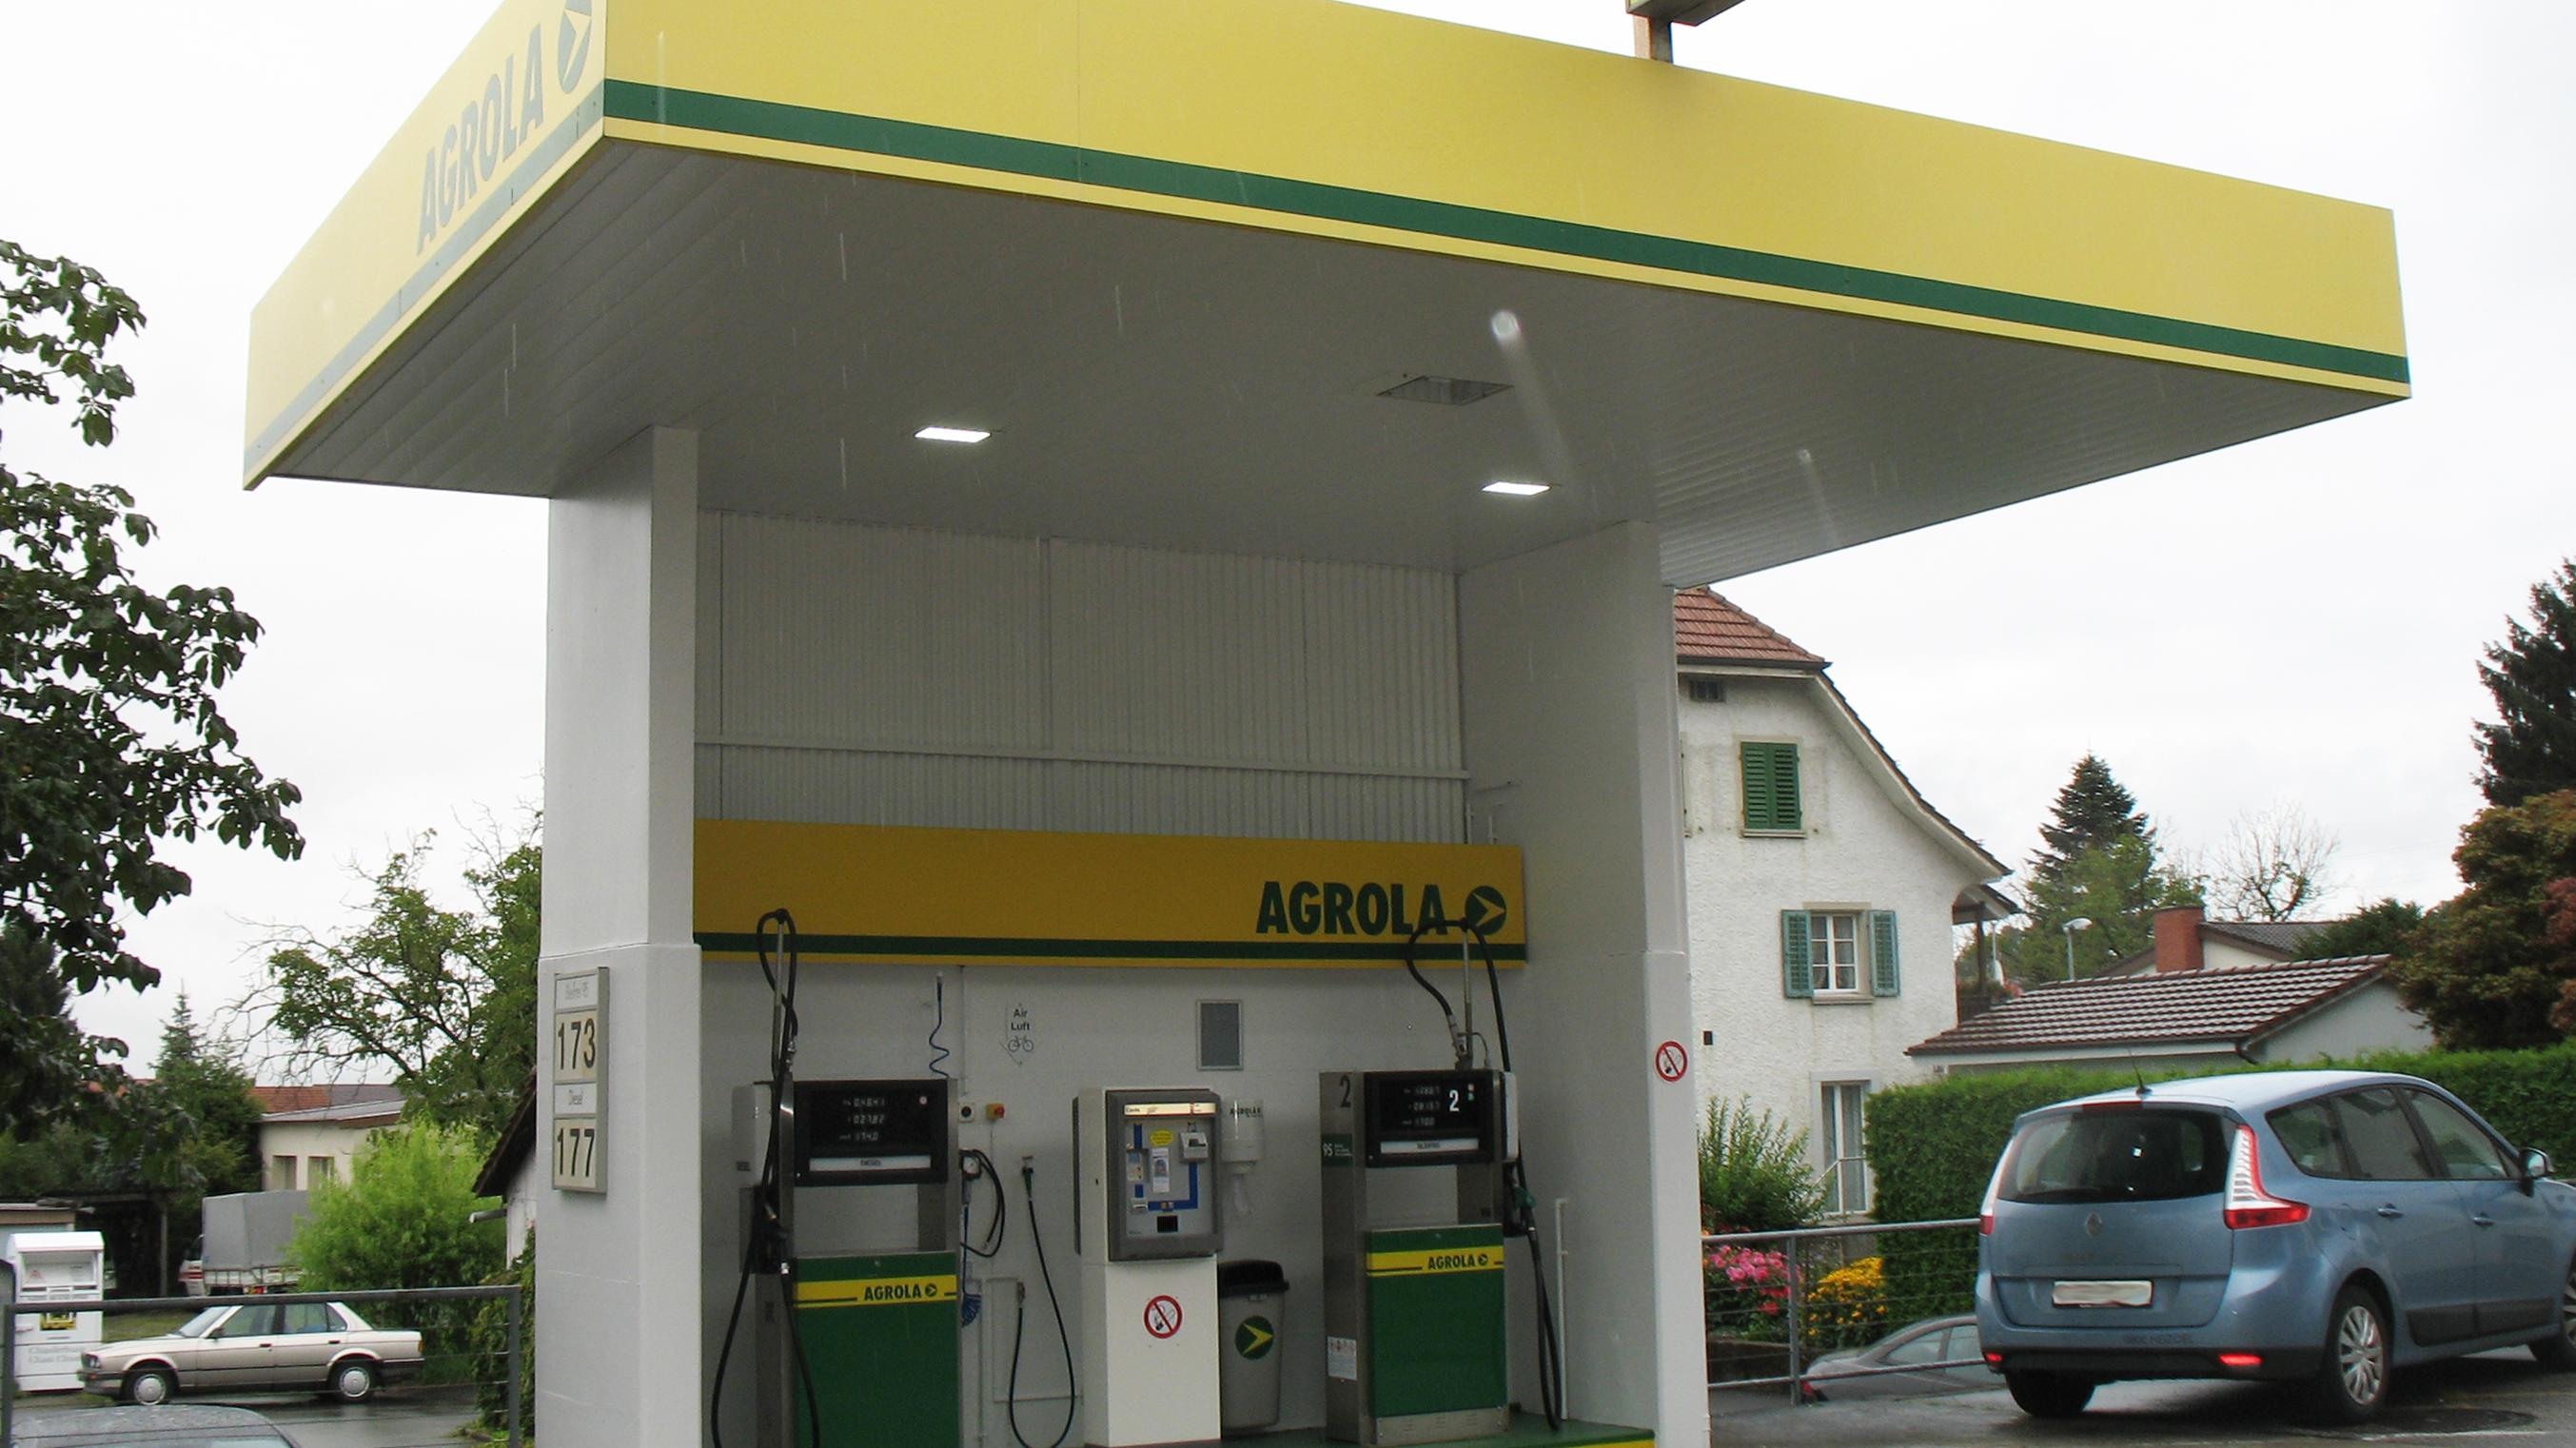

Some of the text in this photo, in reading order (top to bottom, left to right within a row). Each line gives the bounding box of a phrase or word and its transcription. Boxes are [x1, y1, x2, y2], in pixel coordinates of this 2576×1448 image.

[417, 22, 544, 255] AGROLA
[1256, 881, 1448, 935] AGROLA
[1011, 1022, 1030, 1031] Luft
[1013, 1008, 1028, 1018] Air
[557, 1017, 597, 1071] 173
[1339, 1073, 1352, 1108] 2
[1448, 1088, 1460, 1112] 2
[557, 1126, 596, 1179] 177
[1427, 1254, 1476, 1271] AGROLA
[863, 1282, 922, 1301] AGROLA
